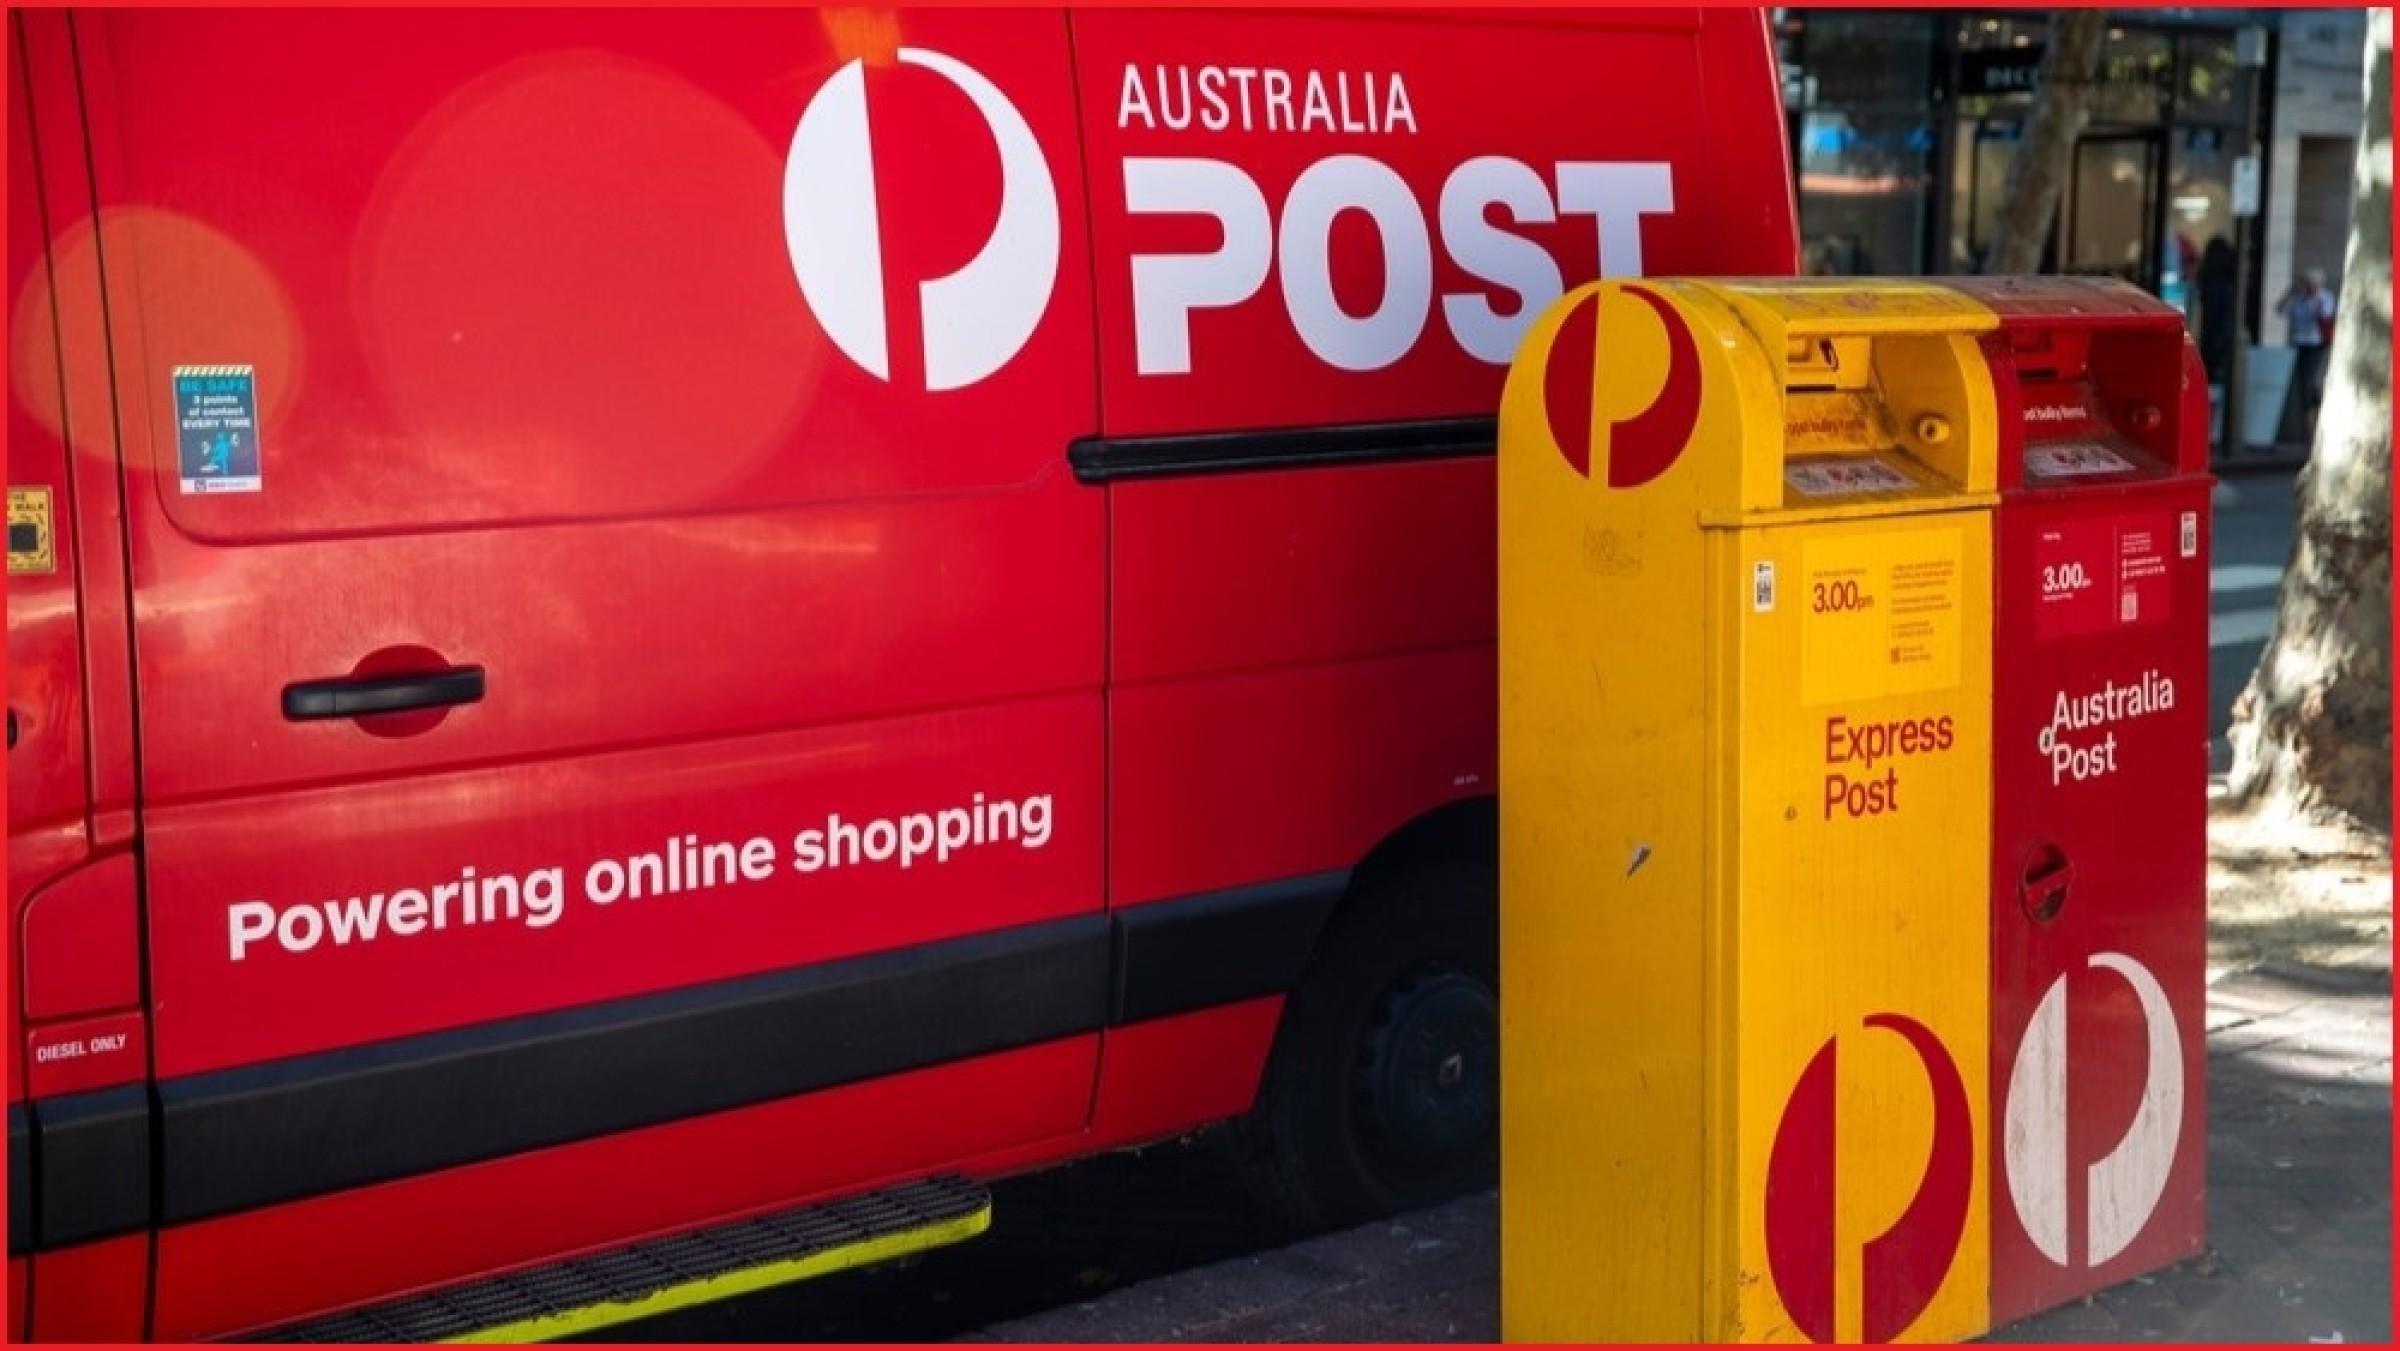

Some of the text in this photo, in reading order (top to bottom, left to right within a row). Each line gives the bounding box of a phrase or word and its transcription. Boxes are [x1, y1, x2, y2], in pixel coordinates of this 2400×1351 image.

[1117, 64, 1417, 133] AUSTRALIA
[1121, 153, 1675, 376] POST
[181, 417, 251, 430] EVERY TIME
[2051, 669, 2174, 733] Australia
[1825, 714, 1955, 769] Express
[2052, 731, 2118, 787] Post
[1824, 767, 1899, 821] Post
[228, 793, 1053, 962] Powering online shopping
[36, 1033, 127, 1063] DIESEL ONLY
